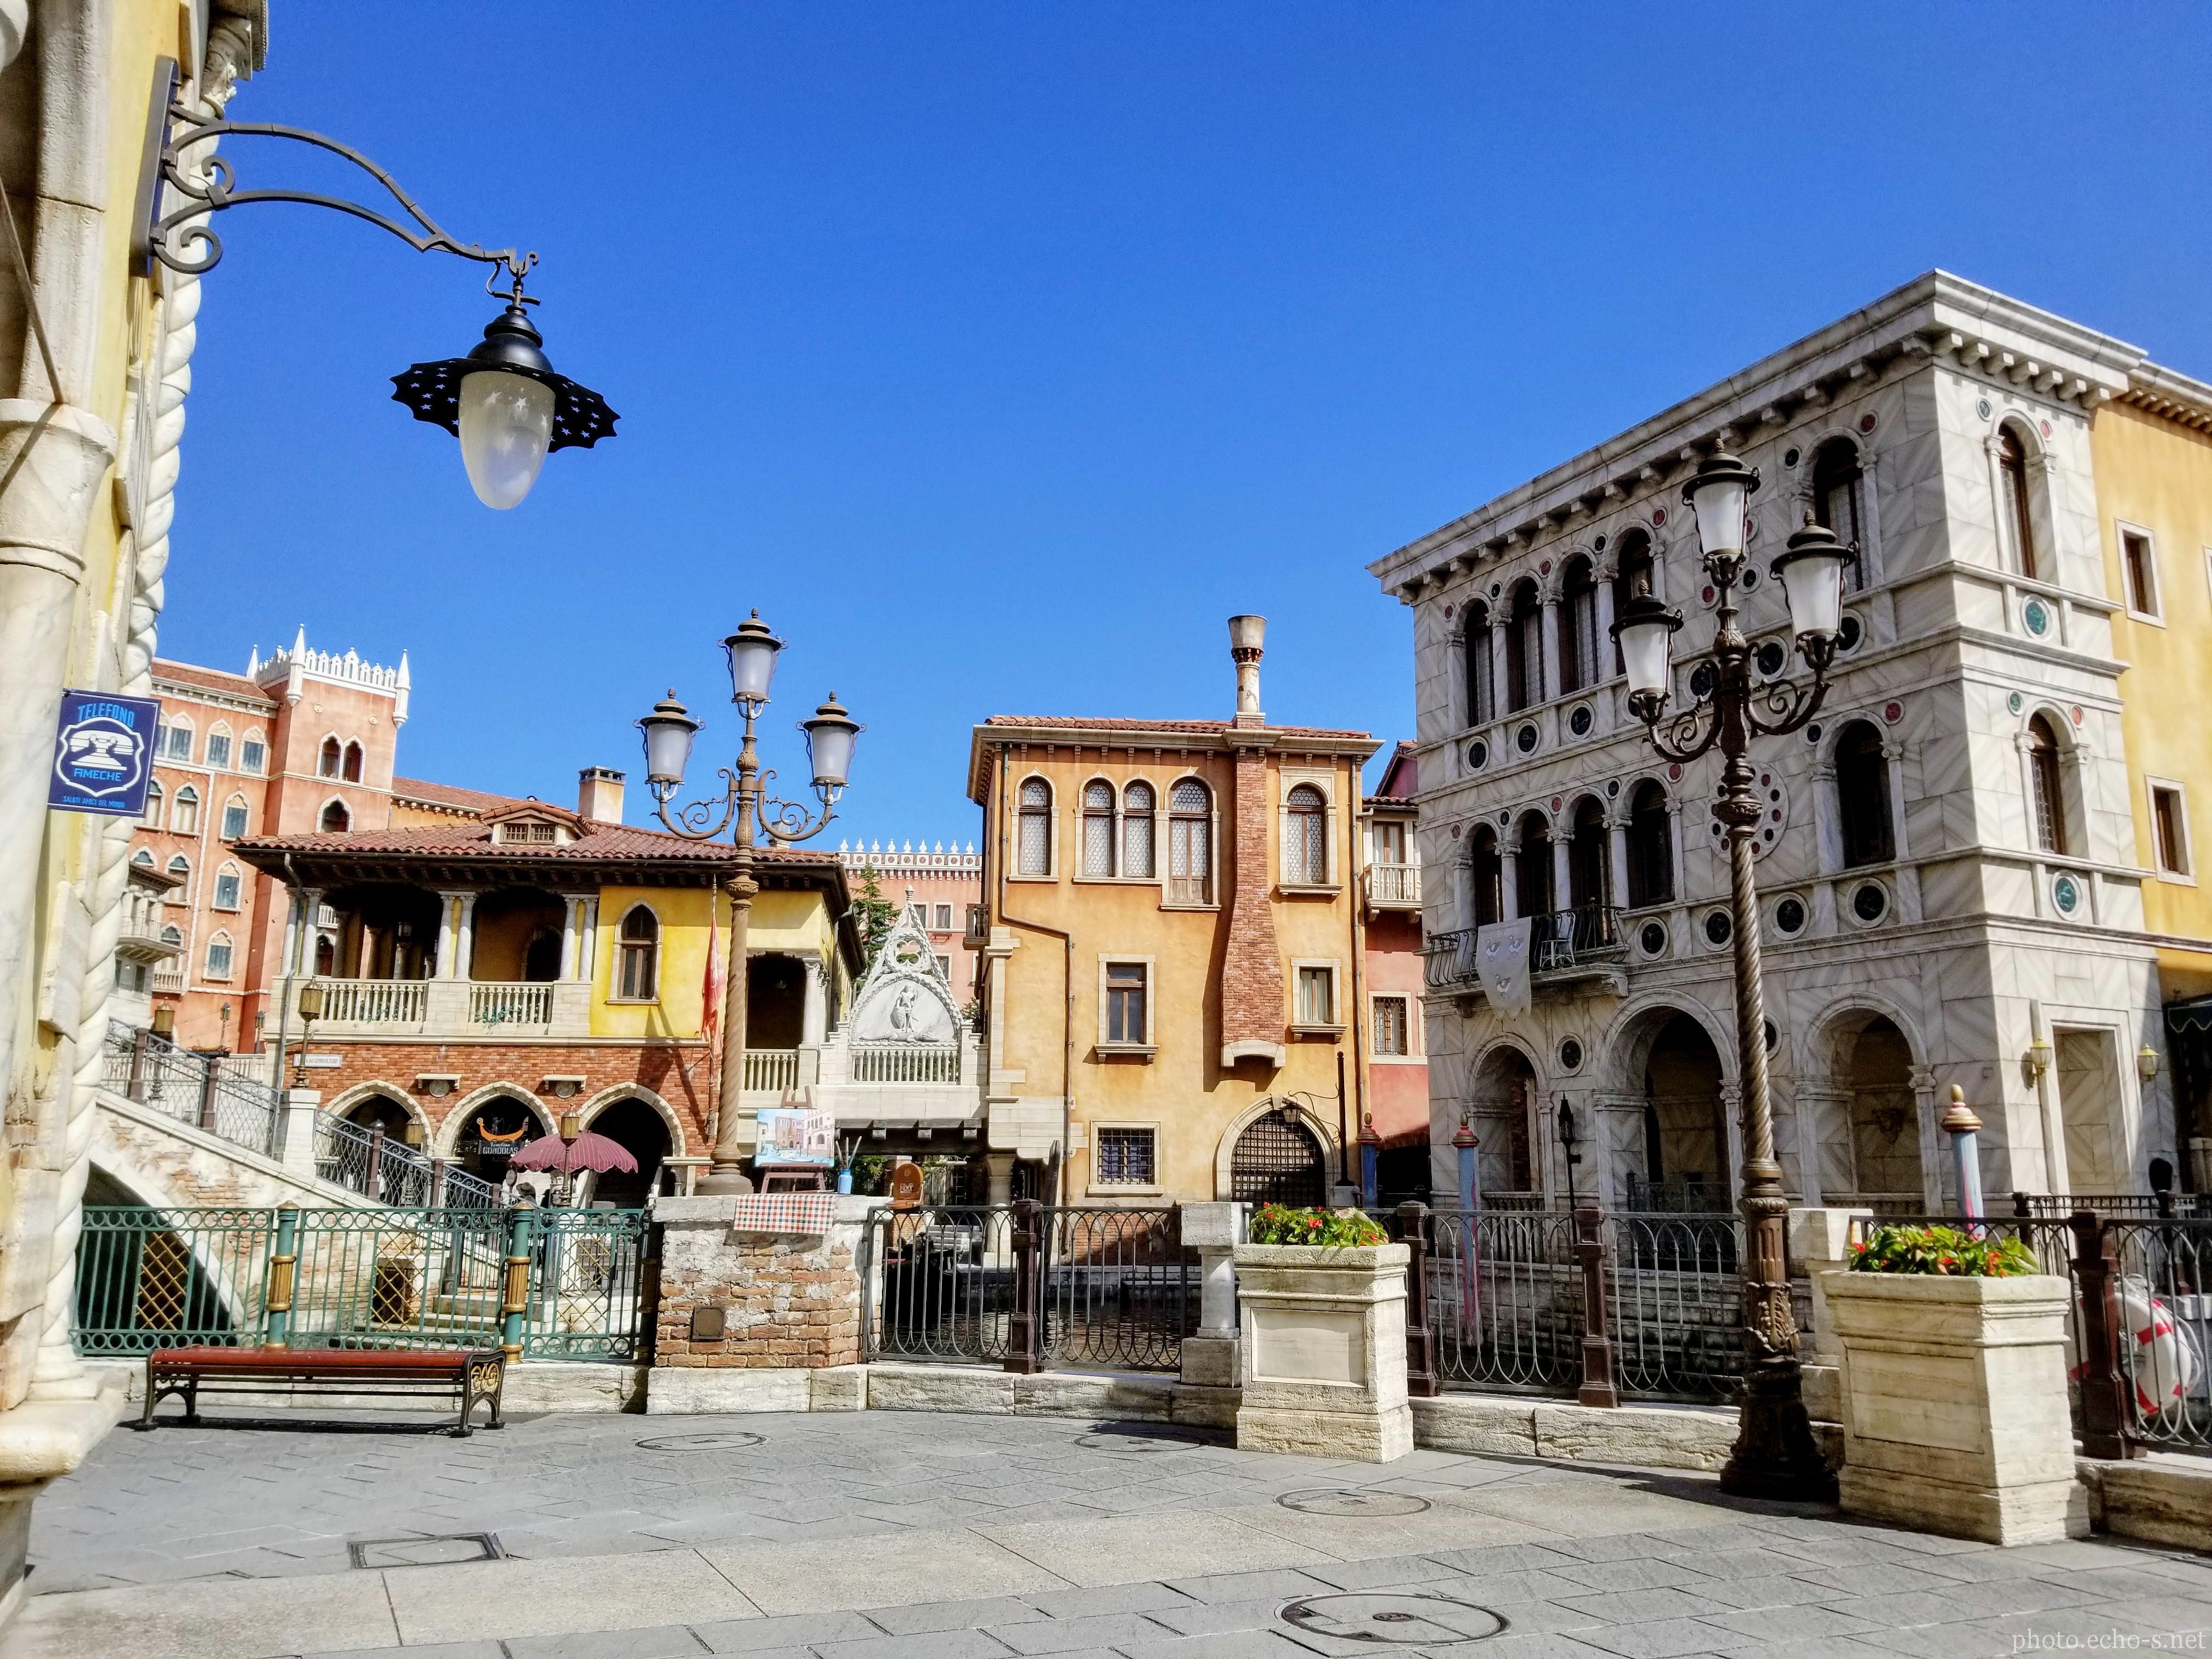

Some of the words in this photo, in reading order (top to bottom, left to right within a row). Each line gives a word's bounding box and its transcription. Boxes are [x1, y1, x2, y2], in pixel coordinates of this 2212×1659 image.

[77, 703, 135, 729] TELEFONO
[74, 768, 122, 781] AMECHE
[483, 1147, 518, 1155] GONDOLAS
